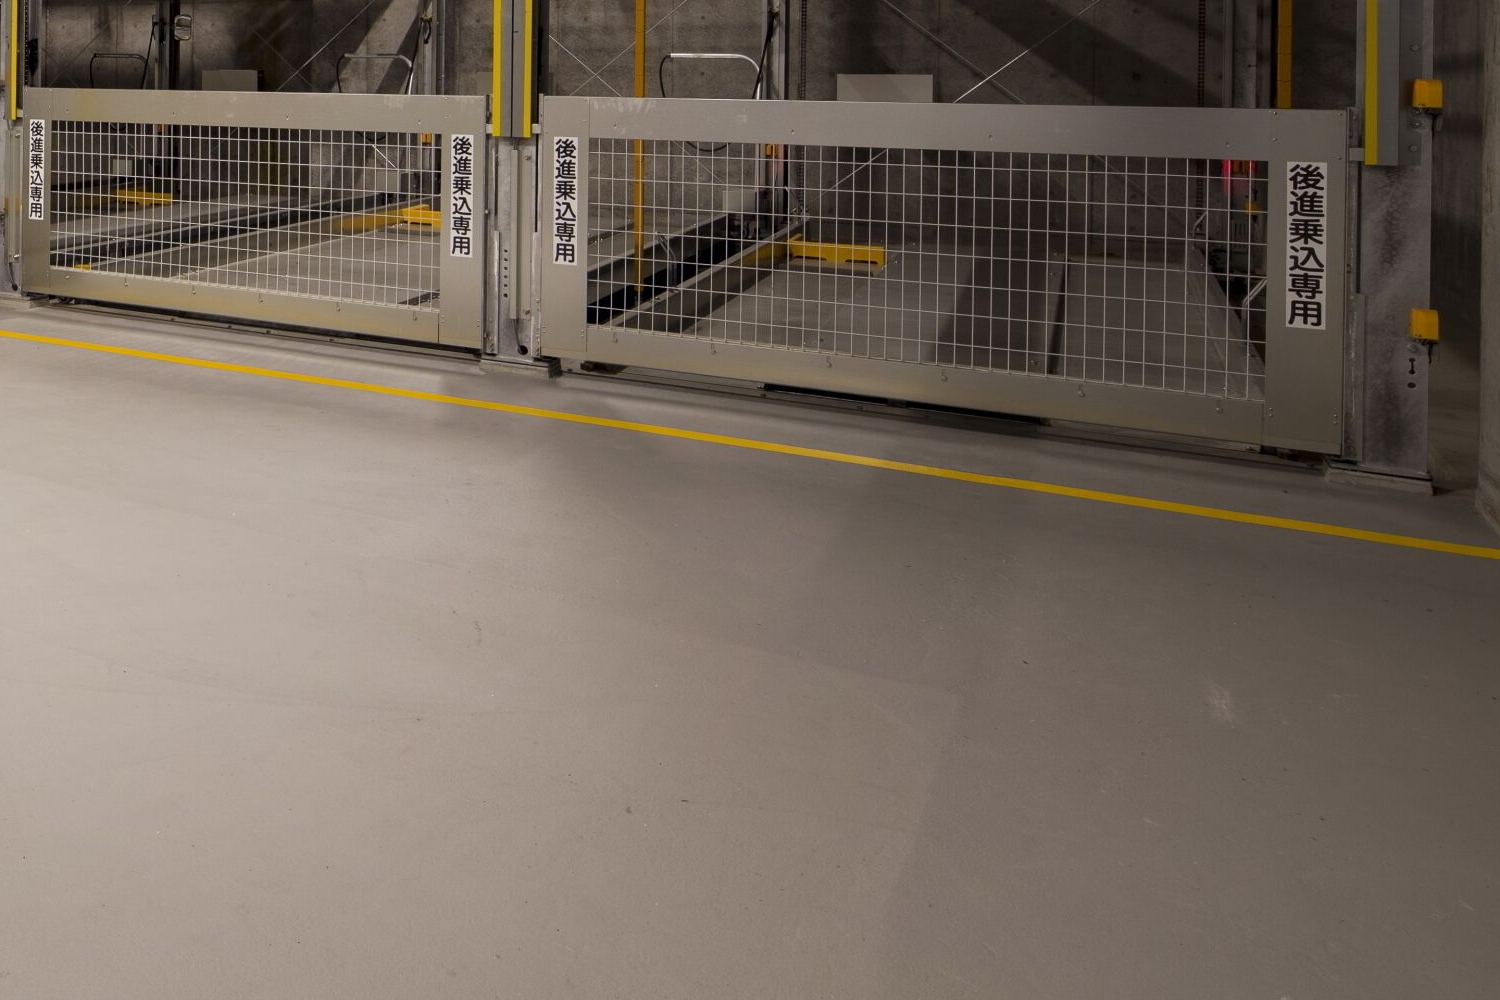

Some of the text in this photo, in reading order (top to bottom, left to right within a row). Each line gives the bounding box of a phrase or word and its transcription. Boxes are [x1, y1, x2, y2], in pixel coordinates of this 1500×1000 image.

[30, 120, 44, 218] 後進乗込専用
[451, 136, 473, 256] 後進乗込専用
[555, 138, 577, 264] 後進乗込専用
[1288, 164, 1325, 327] 後進乗込専用
